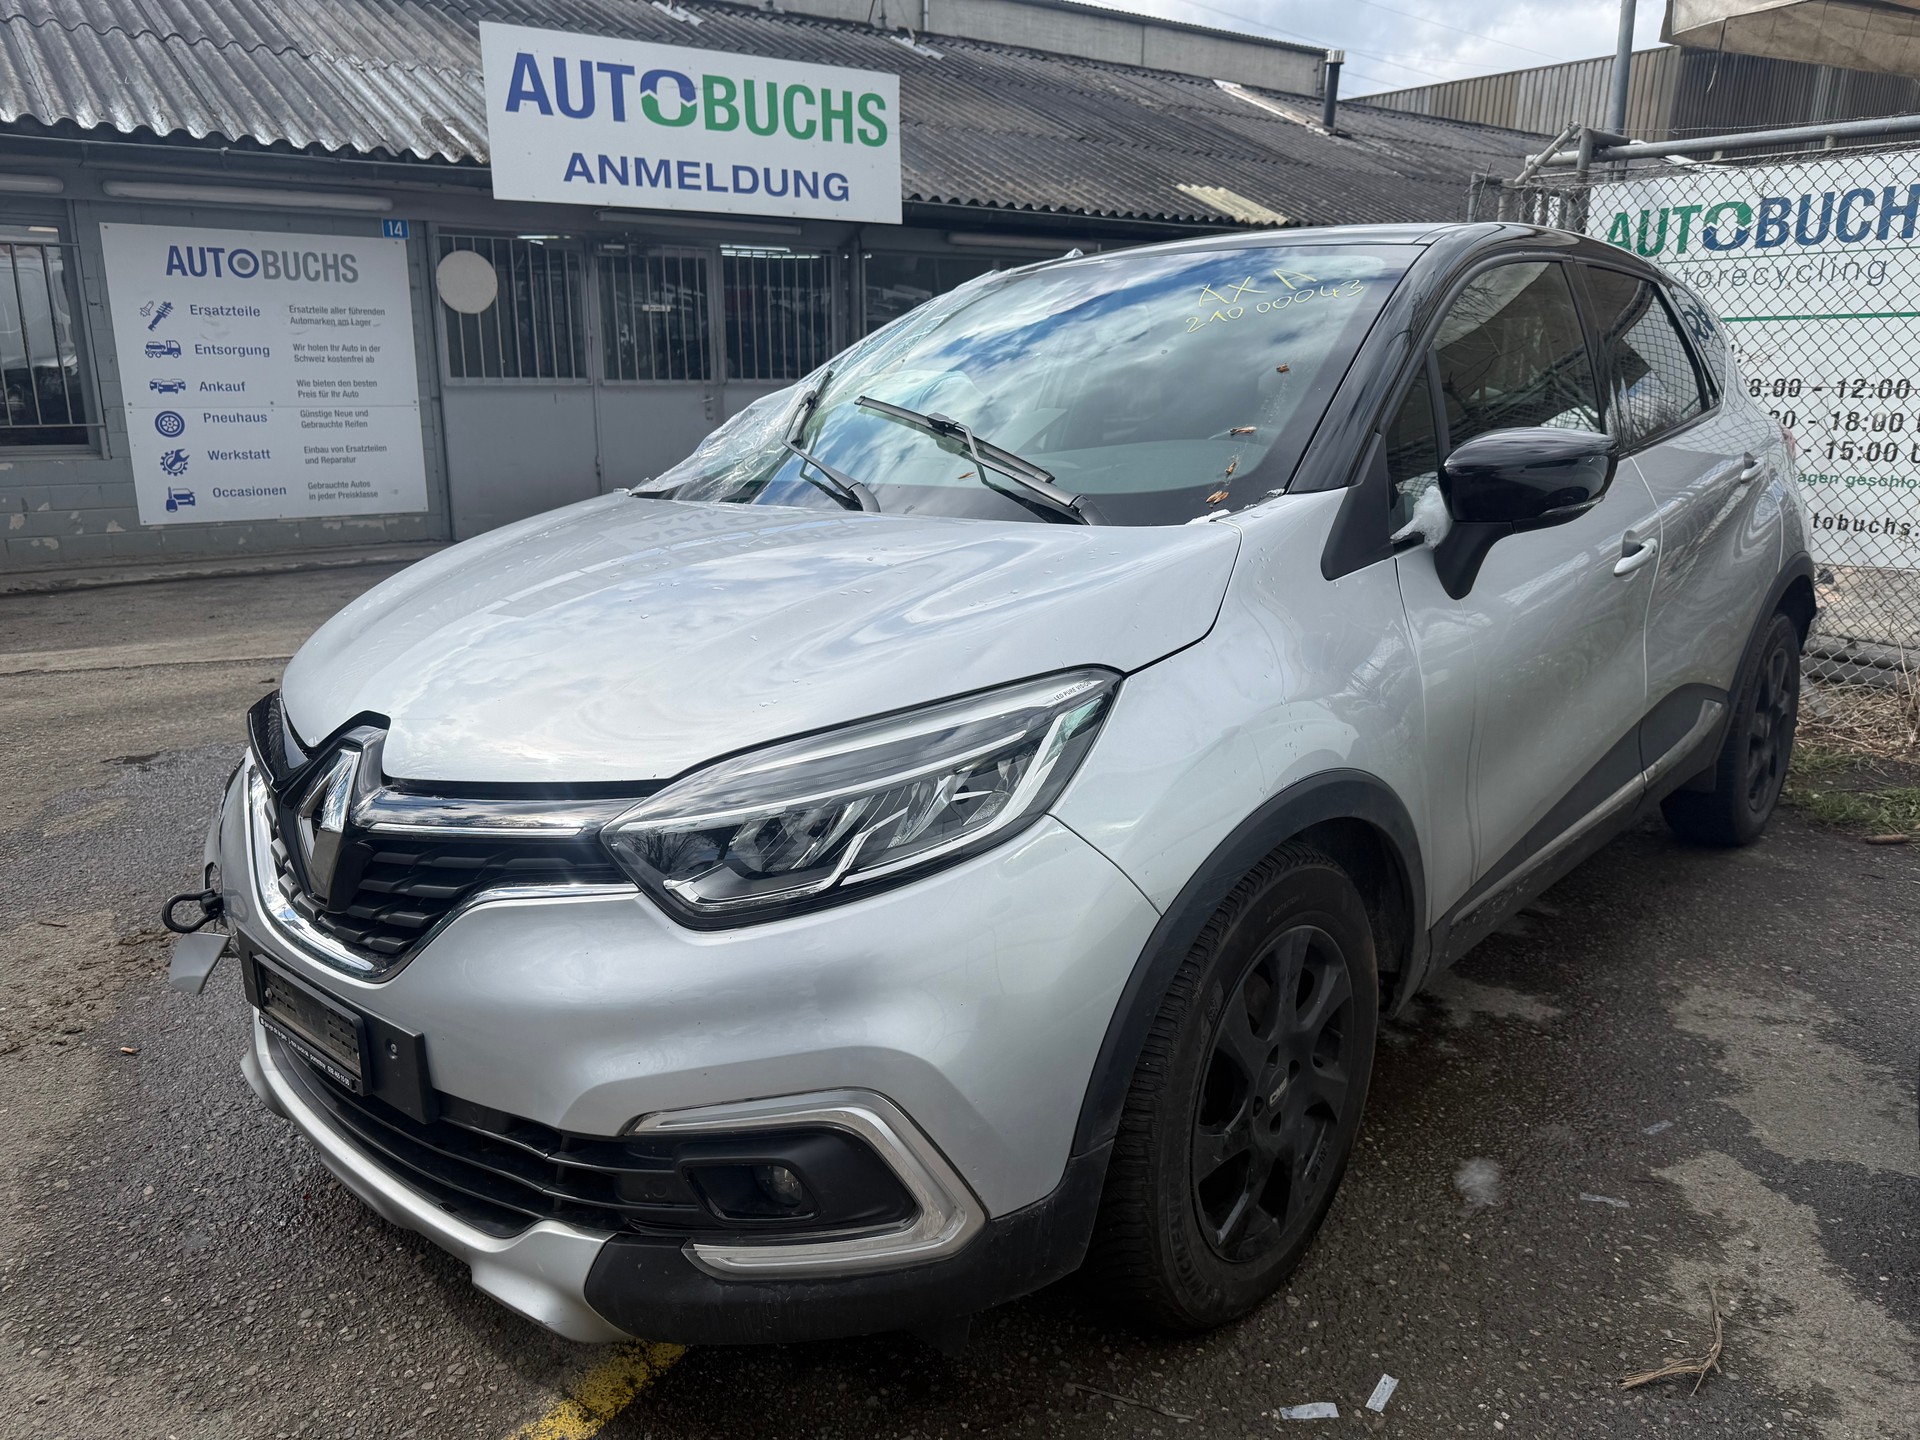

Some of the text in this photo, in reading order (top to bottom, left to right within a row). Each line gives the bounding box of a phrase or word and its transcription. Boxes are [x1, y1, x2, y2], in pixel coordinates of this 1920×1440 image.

[505, 52, 888, 147] AUTOBUCHS
[563, 152, 850, 202] ANMELDUNG
[388, 220, 403, 237] 14
[166, 245, 359, 283] AUTOBUCHS
[190, 304, 261, 317] Ersatzteile
[289, 305, 385, 316] Ersatzteile aller führenden
[290, 316, 336, 326] Automarken
[351, 318, 371, 328] Lager
[195, 344, 270, 358] Entsorgung
[293, 344, 381, 353] Wir holen Ihr Auto in der
[294, 354, 375, 363] Schweiz kostenfrei ab
[199, 381, 246, 392] Ankauf
[313, 379, 336, 387] bieten
[338, 379, 351, 387] den
[353, 379, 377, 387] besten
[1744, 378, 1801, 398] 8:00
[1836, 378, 1911, 399] 12:00
[298, 390, 359, 398] Preis für Ihr Auto
[204, 412, 268, 423] Pneuhaus
[300, 409, 368, 419] Günstige Neue und
[301, 420, 368, 429] Gebrauchte Reifen
[1831, 411, 1904, 433] 18:00
[207, 449, 271, 461] Werkstatt
[304, 446, 329, 454] Einbau
[346, 445, 387, 453] Ersatzteilen
[1826, 441, 1899, 462] 15:00
[321, 456, 356, 465] Reparatur
[307, 480, 371, 490] Gebrauchte Autos
[1845, 474, 1920, 489] geschlo
[212, 485, 287, 498] Occasionen
[318, 492, 336, 501] jeder
[338, 490, 379, 499] Preisklasse
